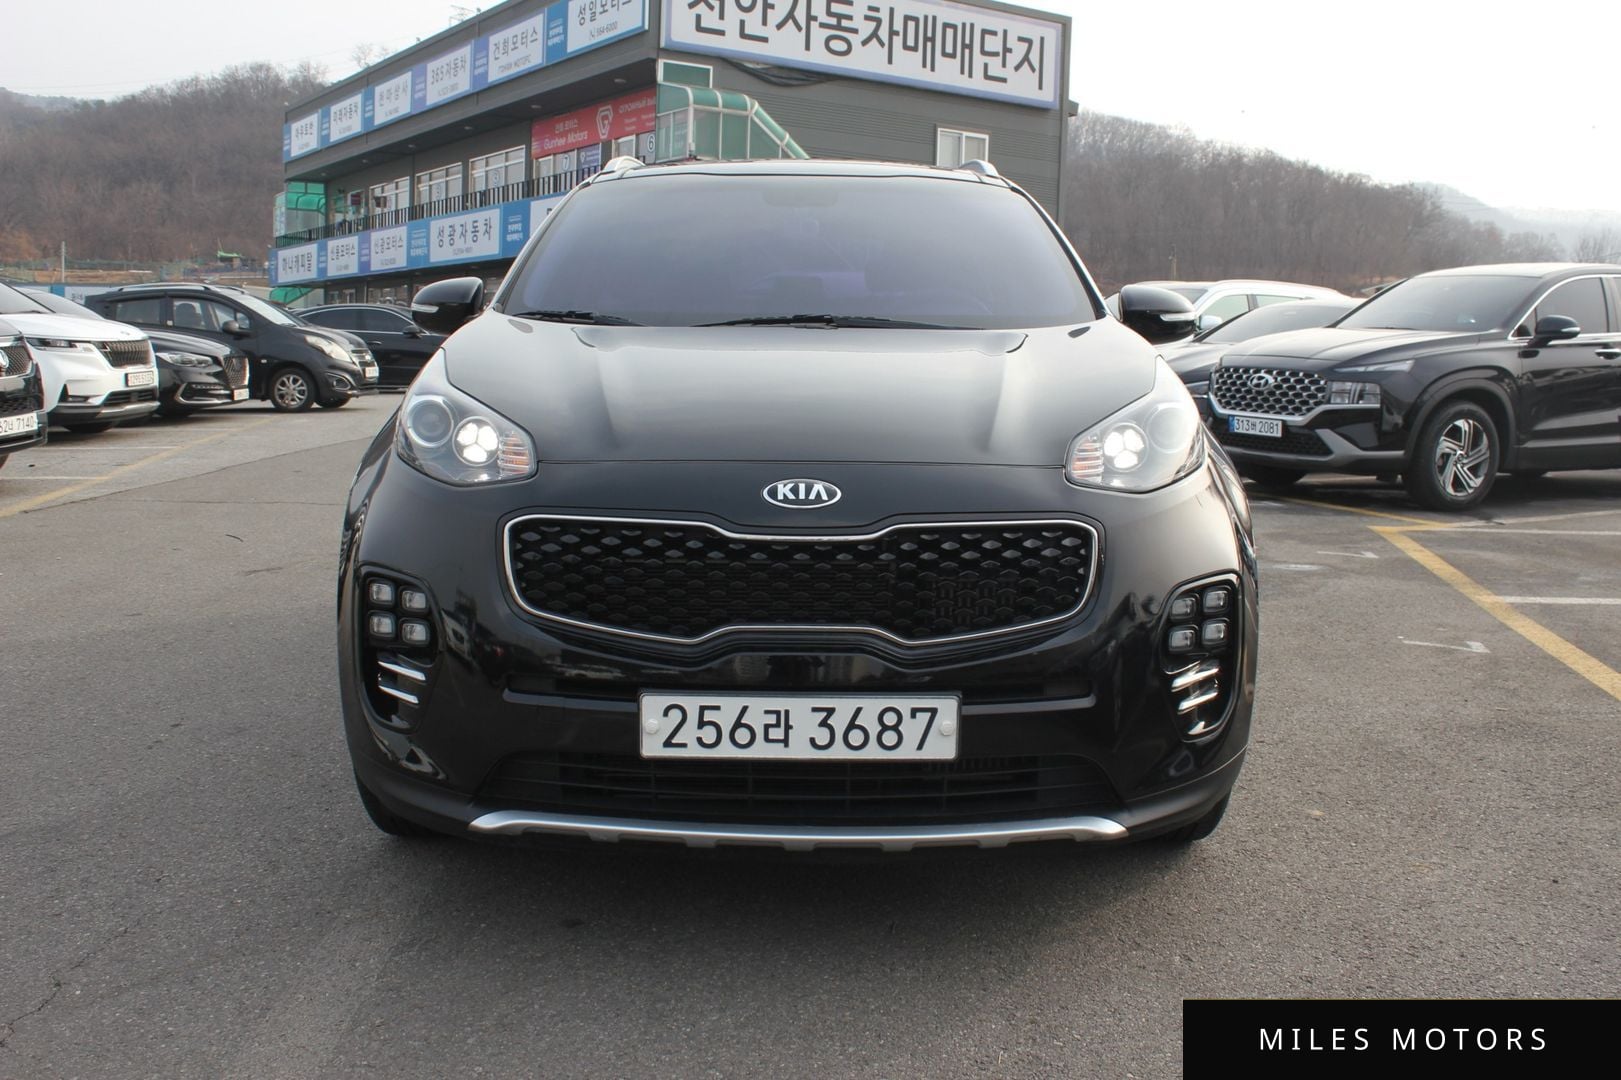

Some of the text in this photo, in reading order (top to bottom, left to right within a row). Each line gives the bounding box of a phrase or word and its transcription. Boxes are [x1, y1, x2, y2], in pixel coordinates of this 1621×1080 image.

[688, 0, 1045, 91] 천안자동차매매단지
[436, 216, 493, 248] 성광자동차
[16, 415, 35, 431] 7140
[1258, 420, 1279, 435] 2081
[777, 482, 829, 501] KIA
[662, 703, 939, 752] 256라 3687
